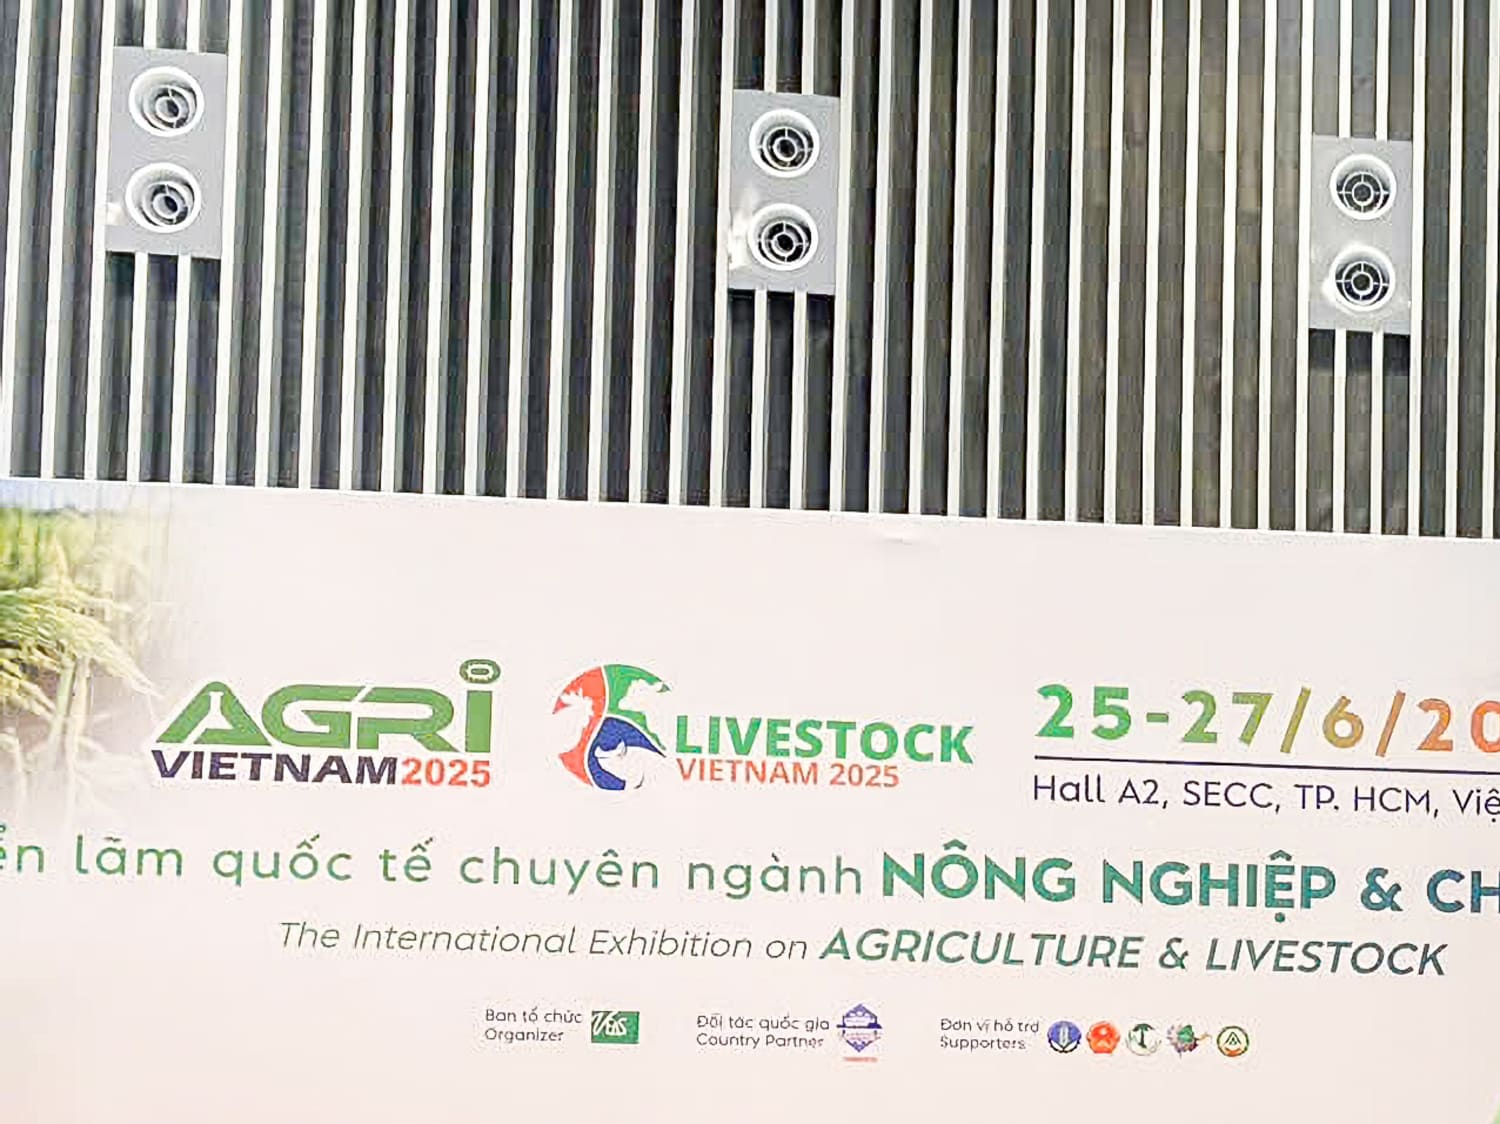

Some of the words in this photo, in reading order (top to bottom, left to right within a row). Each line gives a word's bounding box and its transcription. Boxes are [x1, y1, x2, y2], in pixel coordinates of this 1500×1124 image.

[676, 715, 974, 764] LIVESTOCK
[676, 757, 818, 785] VIETNAM
[830, 762, 899, 787] 2025
[1034, 774, 1105, 802] Hall
[1118, 779, 1167, 809] A2,
[1184, 781, 1280, 813] SECC,
[1294, 784, 1339, 810] TP.
[1354, 786, 1438, 818] HCM,
[76, 835, 182, 876] lãm
[213, 834, 352, 887] quốc
[379, 837, 433, 882] tế
[460, 846, 658, 895] chuyên
[688, 853, 861, 899] ngành
[883, 839, 1075, 902] NÔNG
[1103, 850, 1336, 923] NGHIỆP
[1361, 870, 1403, 911] &
[280, 921, 339, 948] The
[354, 924, 576, 953] International
[589, 928, 751, 957] Exhibition
[766, 940, 807, 959] on
[819, 928, 1144, 968] AGRICULTURE
[1159, 937, 1189, 969] &
[1206, 938, 1448, 975] LIVESTOCK
[486, 1009, 516, 1022] Ban
[805, 1017, 829, 1032] gia
[485, 1028, 564, 1043] Organizer
[697, 1033, 760, 1049] Country
[766, 1034, 824, 1047] Partner
[941, 1036, 1025, 1052] Supporters
